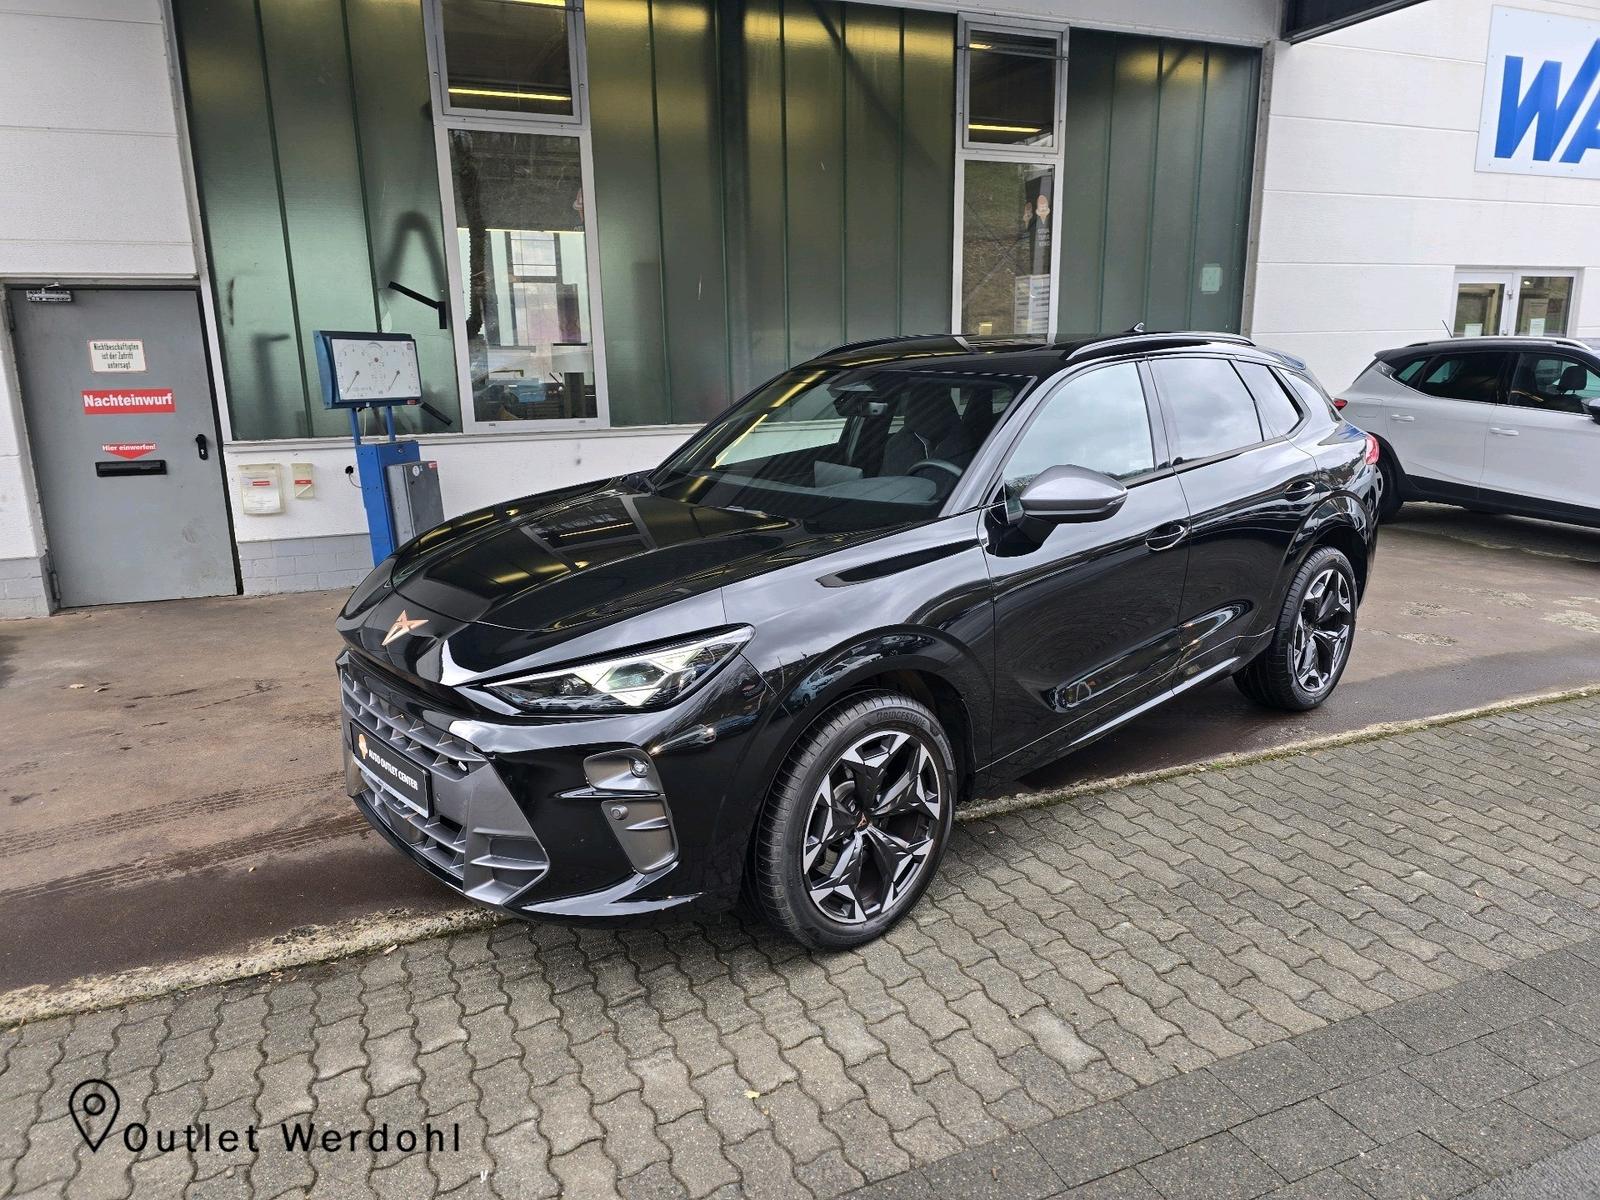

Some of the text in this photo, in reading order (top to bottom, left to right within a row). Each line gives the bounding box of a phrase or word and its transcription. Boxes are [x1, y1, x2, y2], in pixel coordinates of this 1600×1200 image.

[107, 361, 131, 370] untersagt
[83, 393, 172, 407] Nachteinwurf
[119, 443, 156, 451] einwerfen!
[368, 749, 418, 790] AUTO OUTLET CENTER
